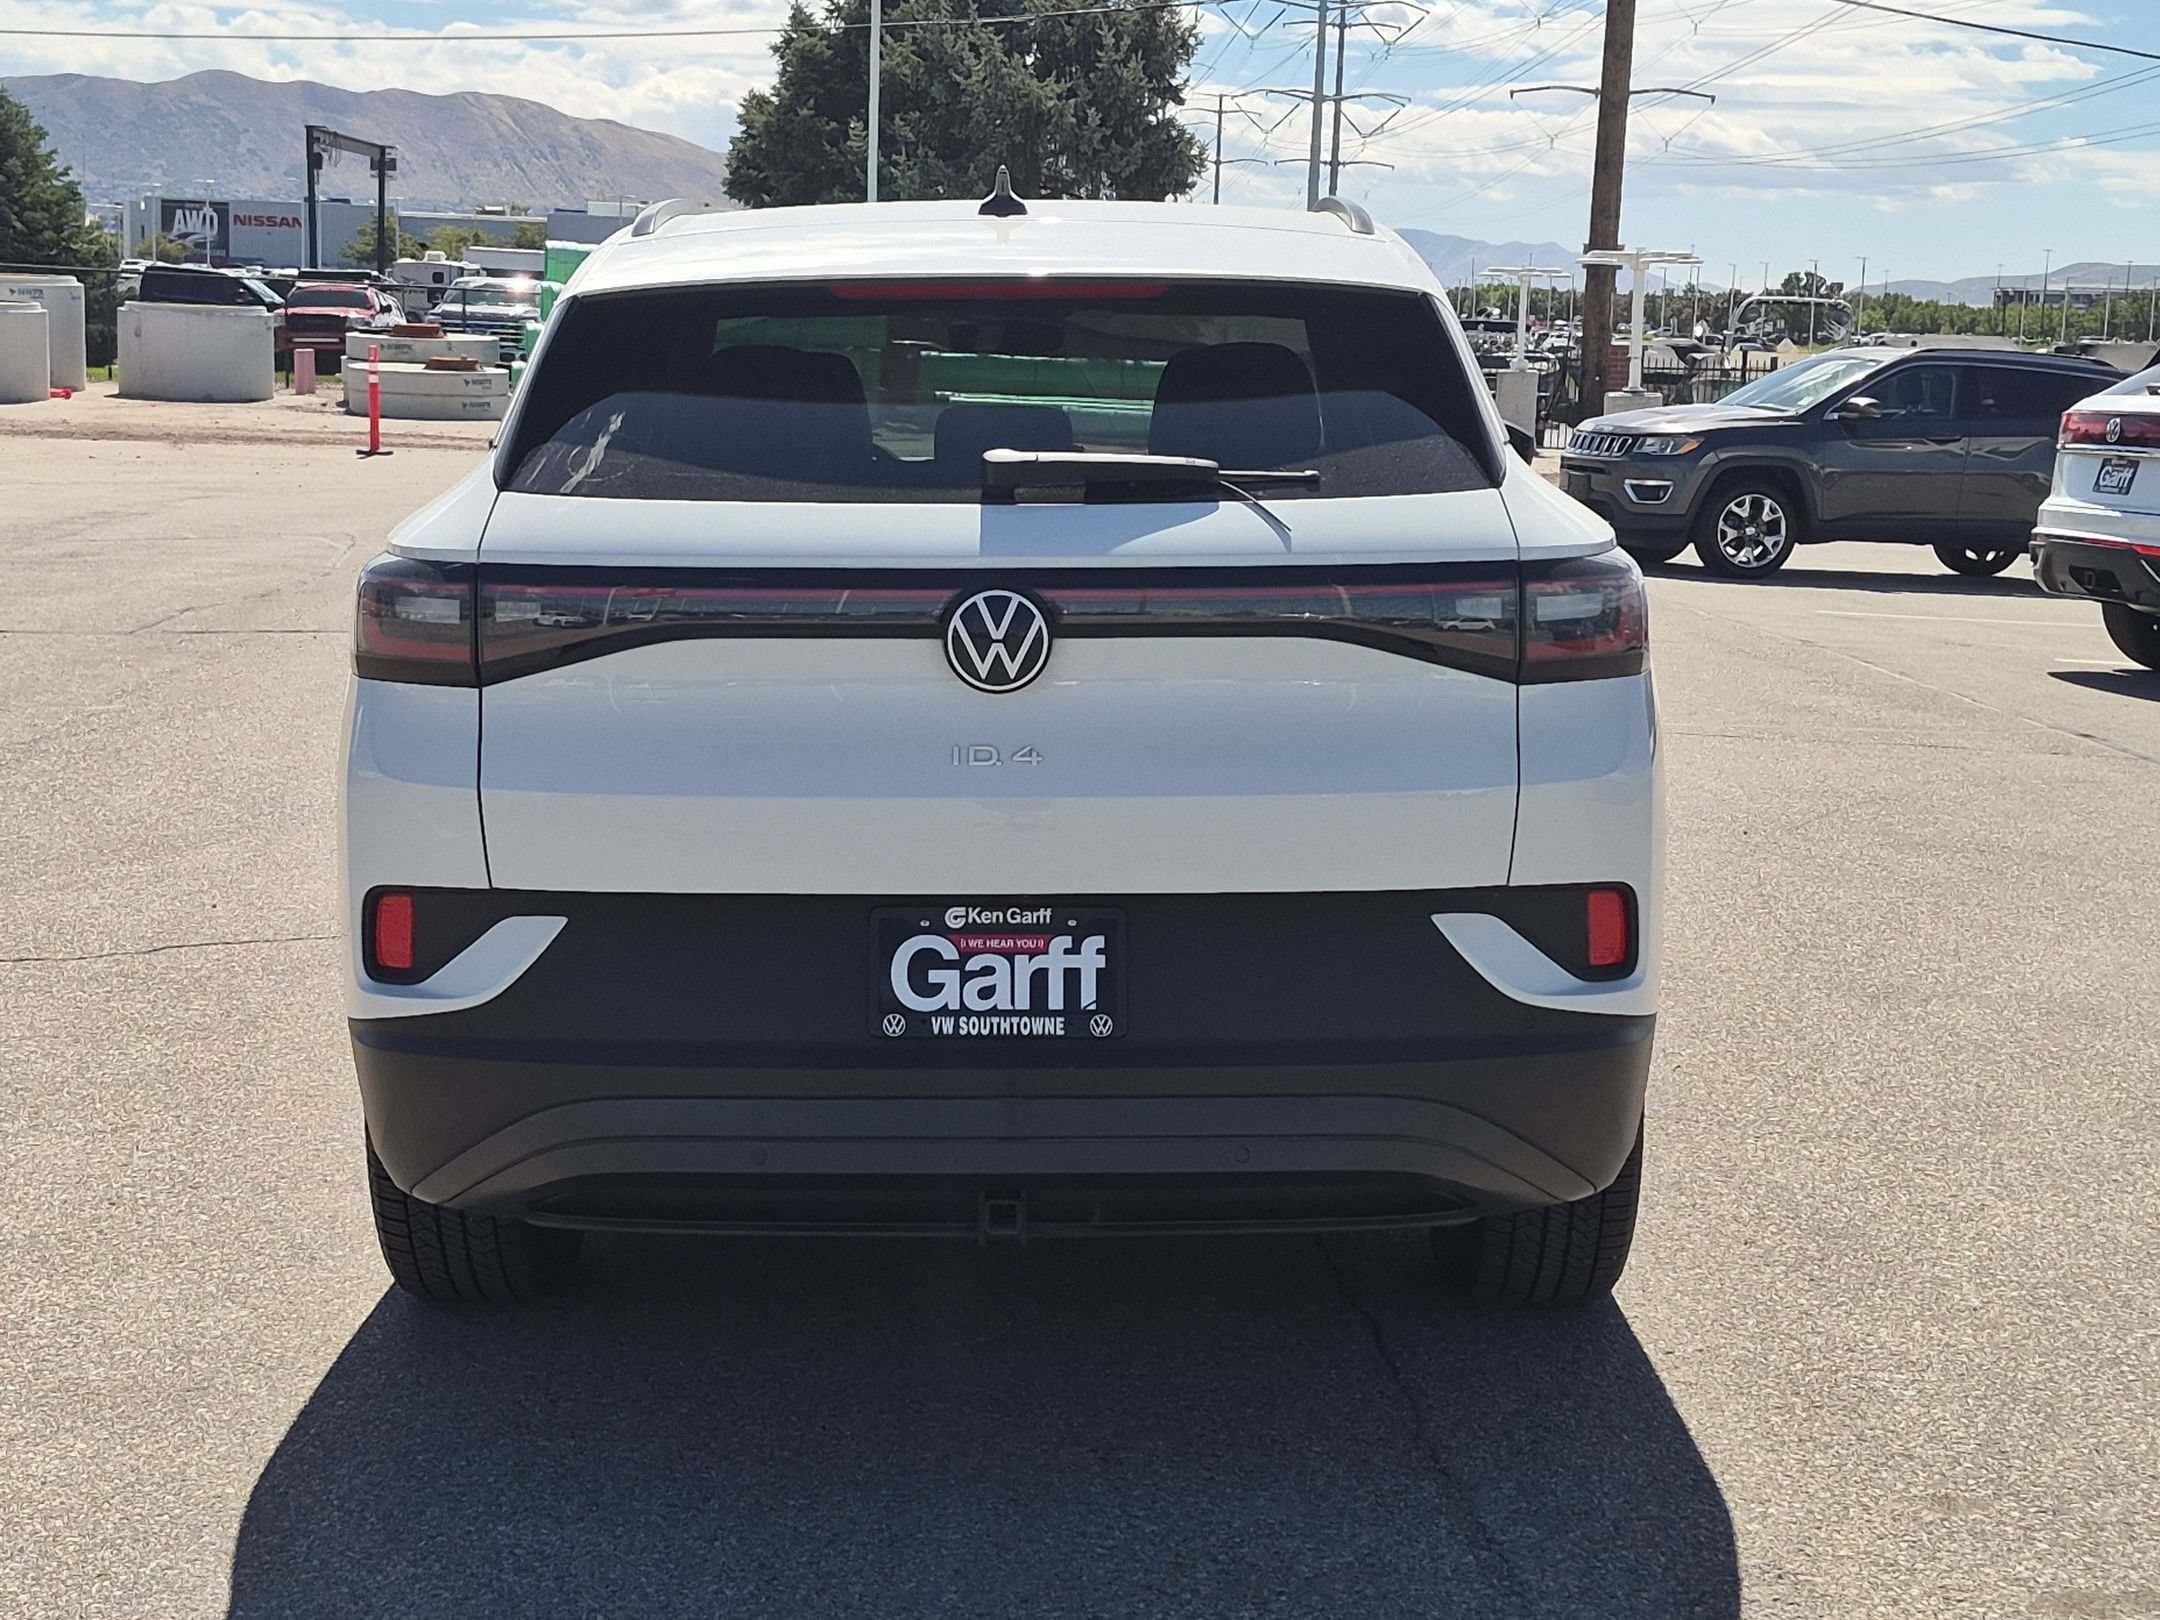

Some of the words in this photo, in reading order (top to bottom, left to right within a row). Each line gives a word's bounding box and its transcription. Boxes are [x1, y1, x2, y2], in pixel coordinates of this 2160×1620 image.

[172, 208, 219, 235] AWD
[233, 214, 302, 228] NISSAN
[2099, 465, 2135, 488] Garff
[967, 906, 1004, 924] Ken
[1006, 907, 1053, 924] Garff
[1016, 938, 1037, 949] YOU
[890, 934, 1106, 1012] Garff
[931, 1016, 954, 1036] VW
[959, 1016, 1066, 1036] SOUTHTOWNE
